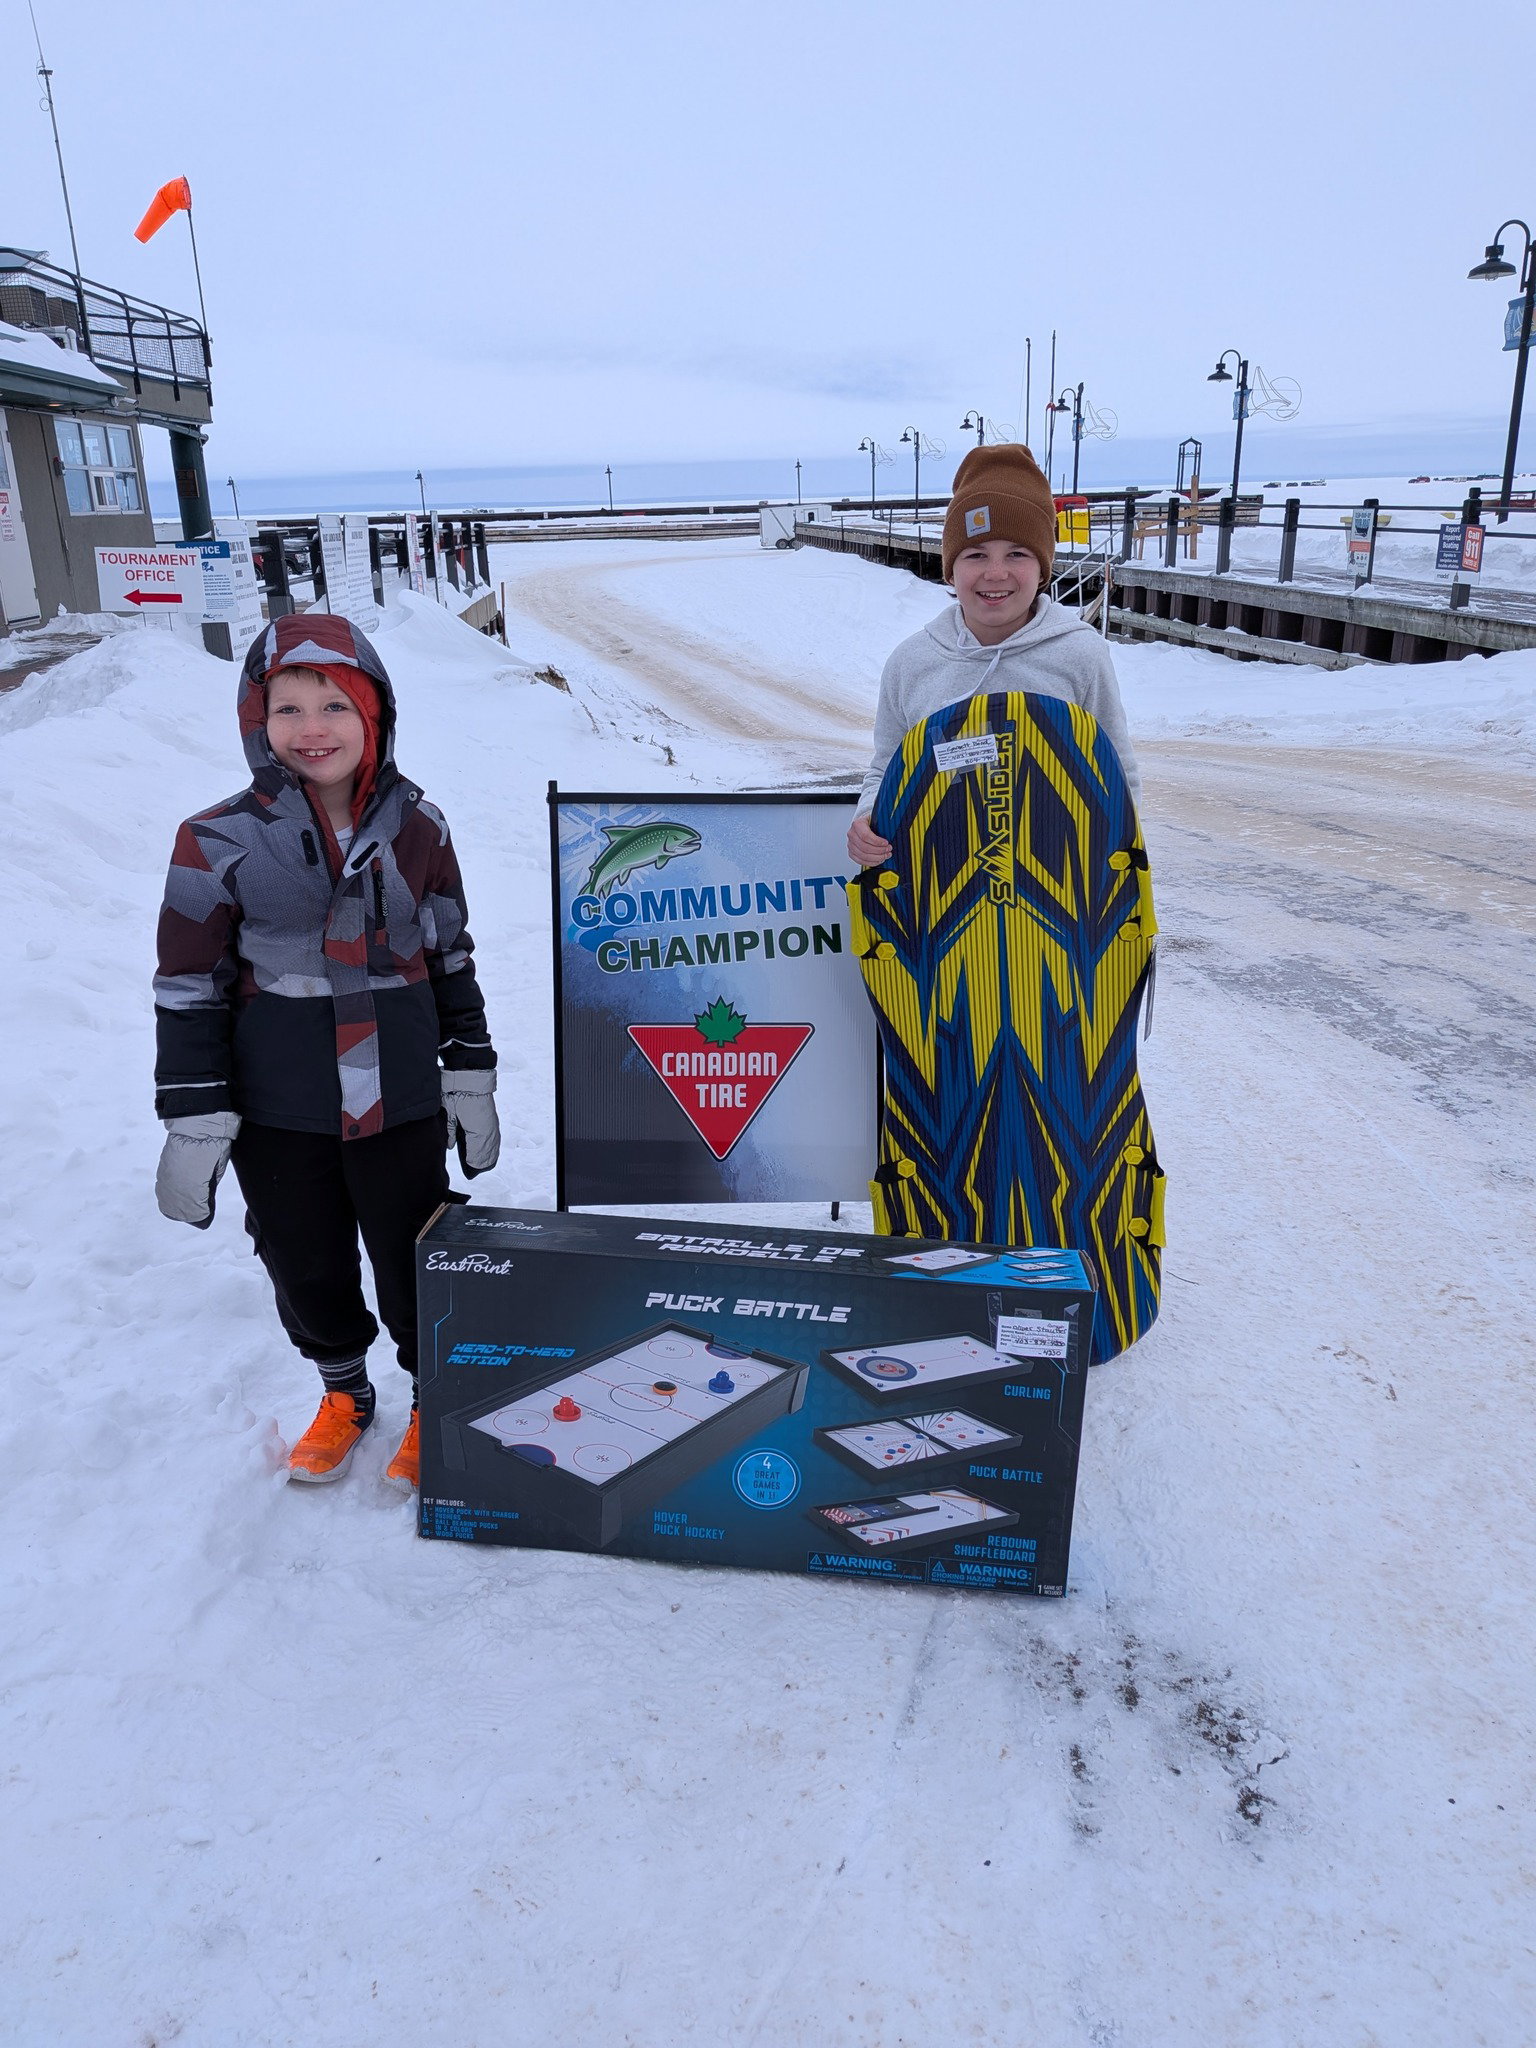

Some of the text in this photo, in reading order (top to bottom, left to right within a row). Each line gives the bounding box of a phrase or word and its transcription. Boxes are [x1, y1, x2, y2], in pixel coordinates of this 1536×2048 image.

[1468, 531, 1480, 540] Call
[1465, 540, 1480, 559] 911
[99, 553, 197, 566] TOURNAMENT
[125, 570, 175, 582] OFFICE
[596, 923, 843, 974] CHAMPION
[661, 1052, 778, 1077] CANADIAN
[695, 1083, 747, 1108] TIRE
[635, 1232, 866, 1257] BATAILLE DE
[425, 1251, 514, 1275] EastPoint
[644, 1292, 852, 1324] PUCK BATTLE
[452, 1343, 576, 1358] HEAD-TO-HEAD
[446, 1354, 512, 1366] ACTION
[1003, 1384, 1051, 1400] CURLING
[762, 1456, 772, 1469] 4
[754, 1470, 780, 1480] GREAT
[969, 1465, 1044, 1484] PUCK BATTLE
[753, 1480, 781, 1490] GAMES
[436, 1499, 466, 1507] INCLUDES:
[757, 1491, 765, 1499] IN
[492, 1511, 521, 1519] CHARGER
[653, 1511, 688, 1524] HOVER
[653, 1523, 726, 1540] PUCK HOCKEY
[987, 1535, 1037, 1551] REBOUND
[954, 1544, 1036, 1563] SHUFFLEBOARD
[825, 1555, 897, 1572] WARNING:
[960, 1562, 1032, 1581] WARNING:
[931, 1572, 965, 1580] CHOKING
[967, 1575, 997, 1583] HAZARD
